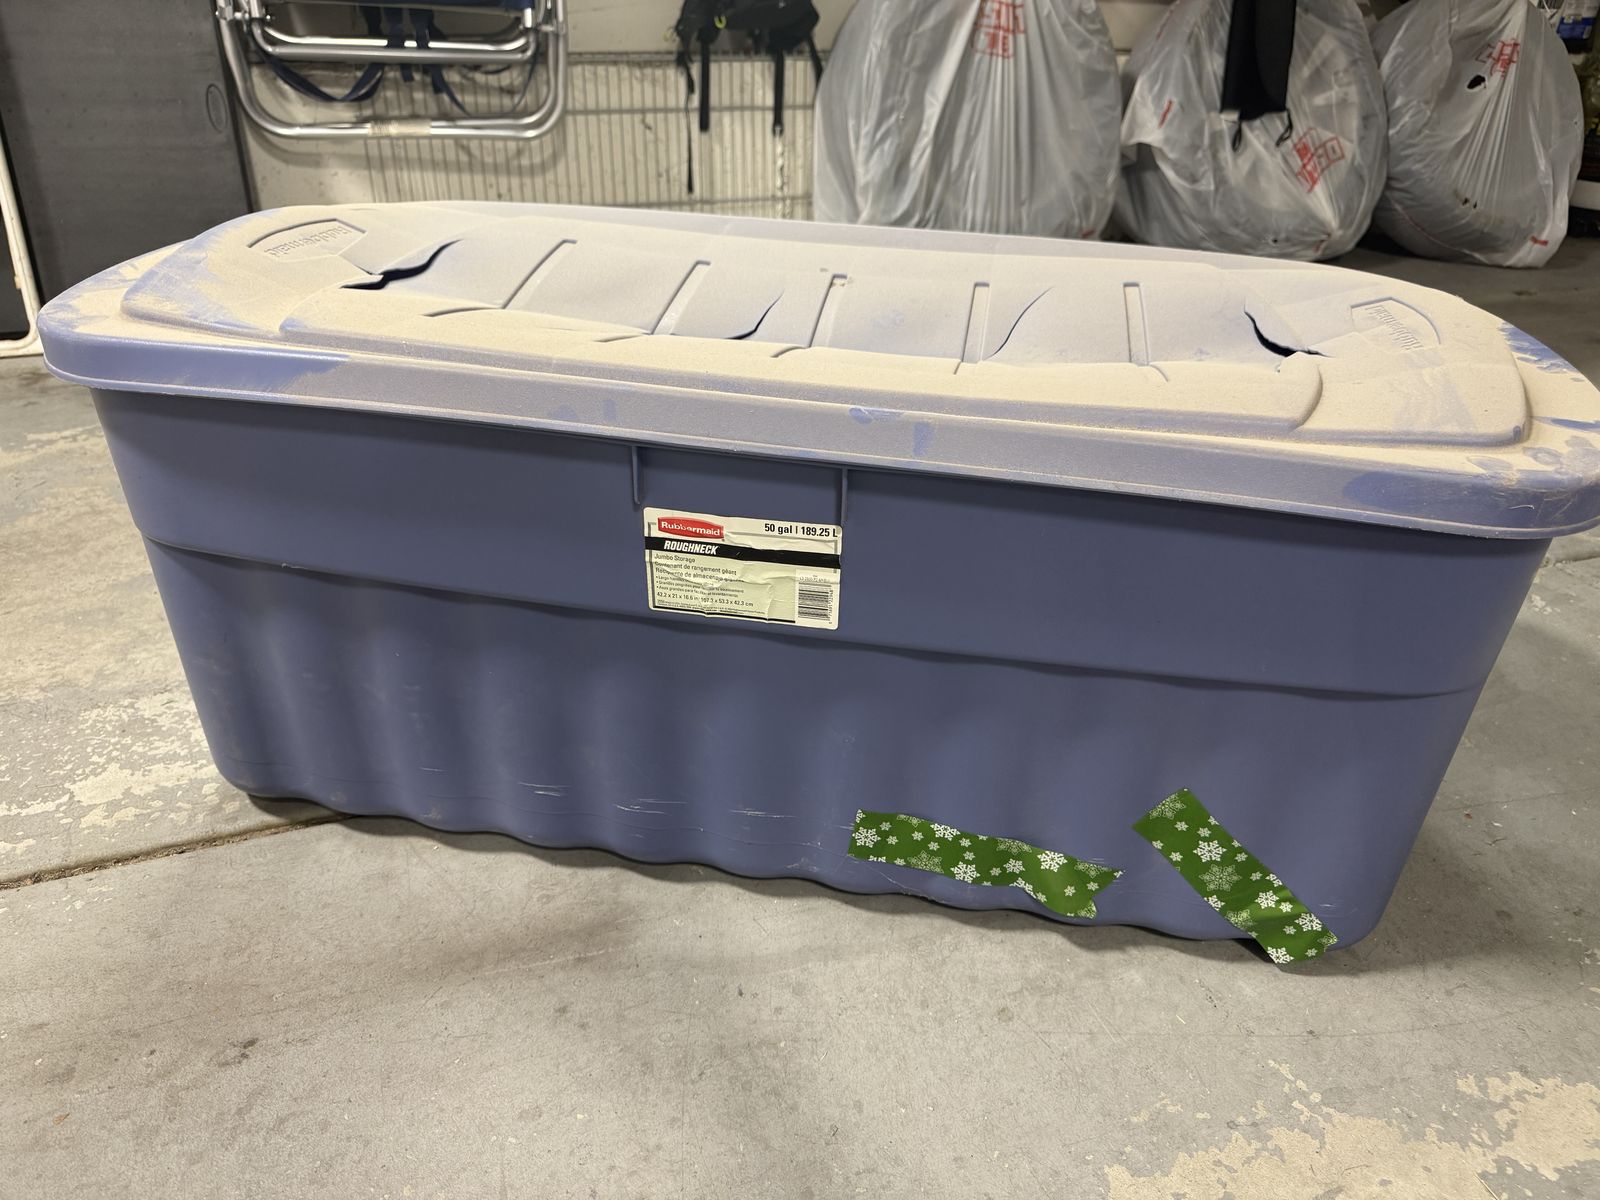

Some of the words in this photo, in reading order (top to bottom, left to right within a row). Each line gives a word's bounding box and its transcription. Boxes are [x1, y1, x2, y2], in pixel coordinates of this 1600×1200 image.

[661, 520, 721, 537] Rubbermaid
[764, 523, 775, 533] 50
[777, 525, 793, 535] gal
[801, 526, 830, 538] 189.25
[832, 528, 838, 538] L
[664, 540, 719, 555] ROUGHNECK
[654, 553, 674, 561] Jumbo
[673, 555, 696, 563] Storage
[691, 565, 721, 573] rangement
